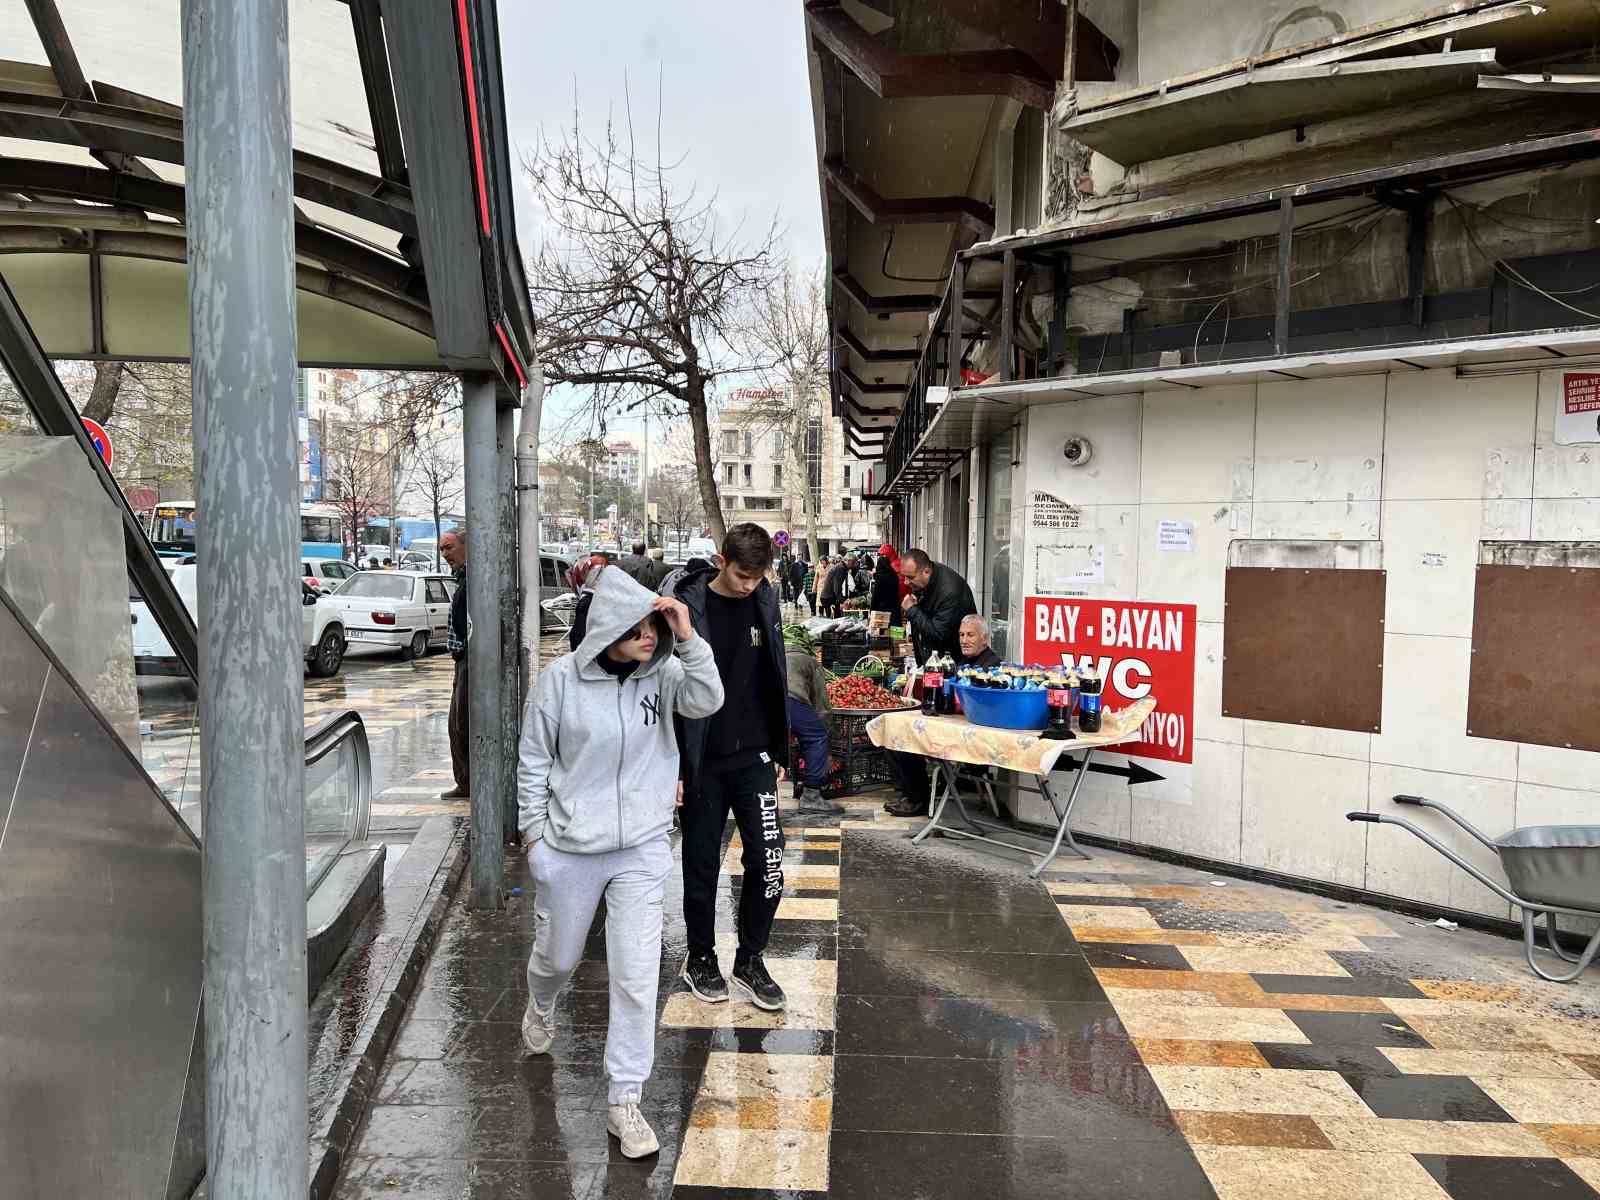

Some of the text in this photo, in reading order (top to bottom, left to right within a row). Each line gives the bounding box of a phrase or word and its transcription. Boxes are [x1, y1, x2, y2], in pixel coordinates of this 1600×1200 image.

[1035, 604, 1080, 643] BAY
[1101, 607, 1183, 652] BAYAN
[640, 693, 661, 727] NY
[757, 792, 780, 841] Dark
